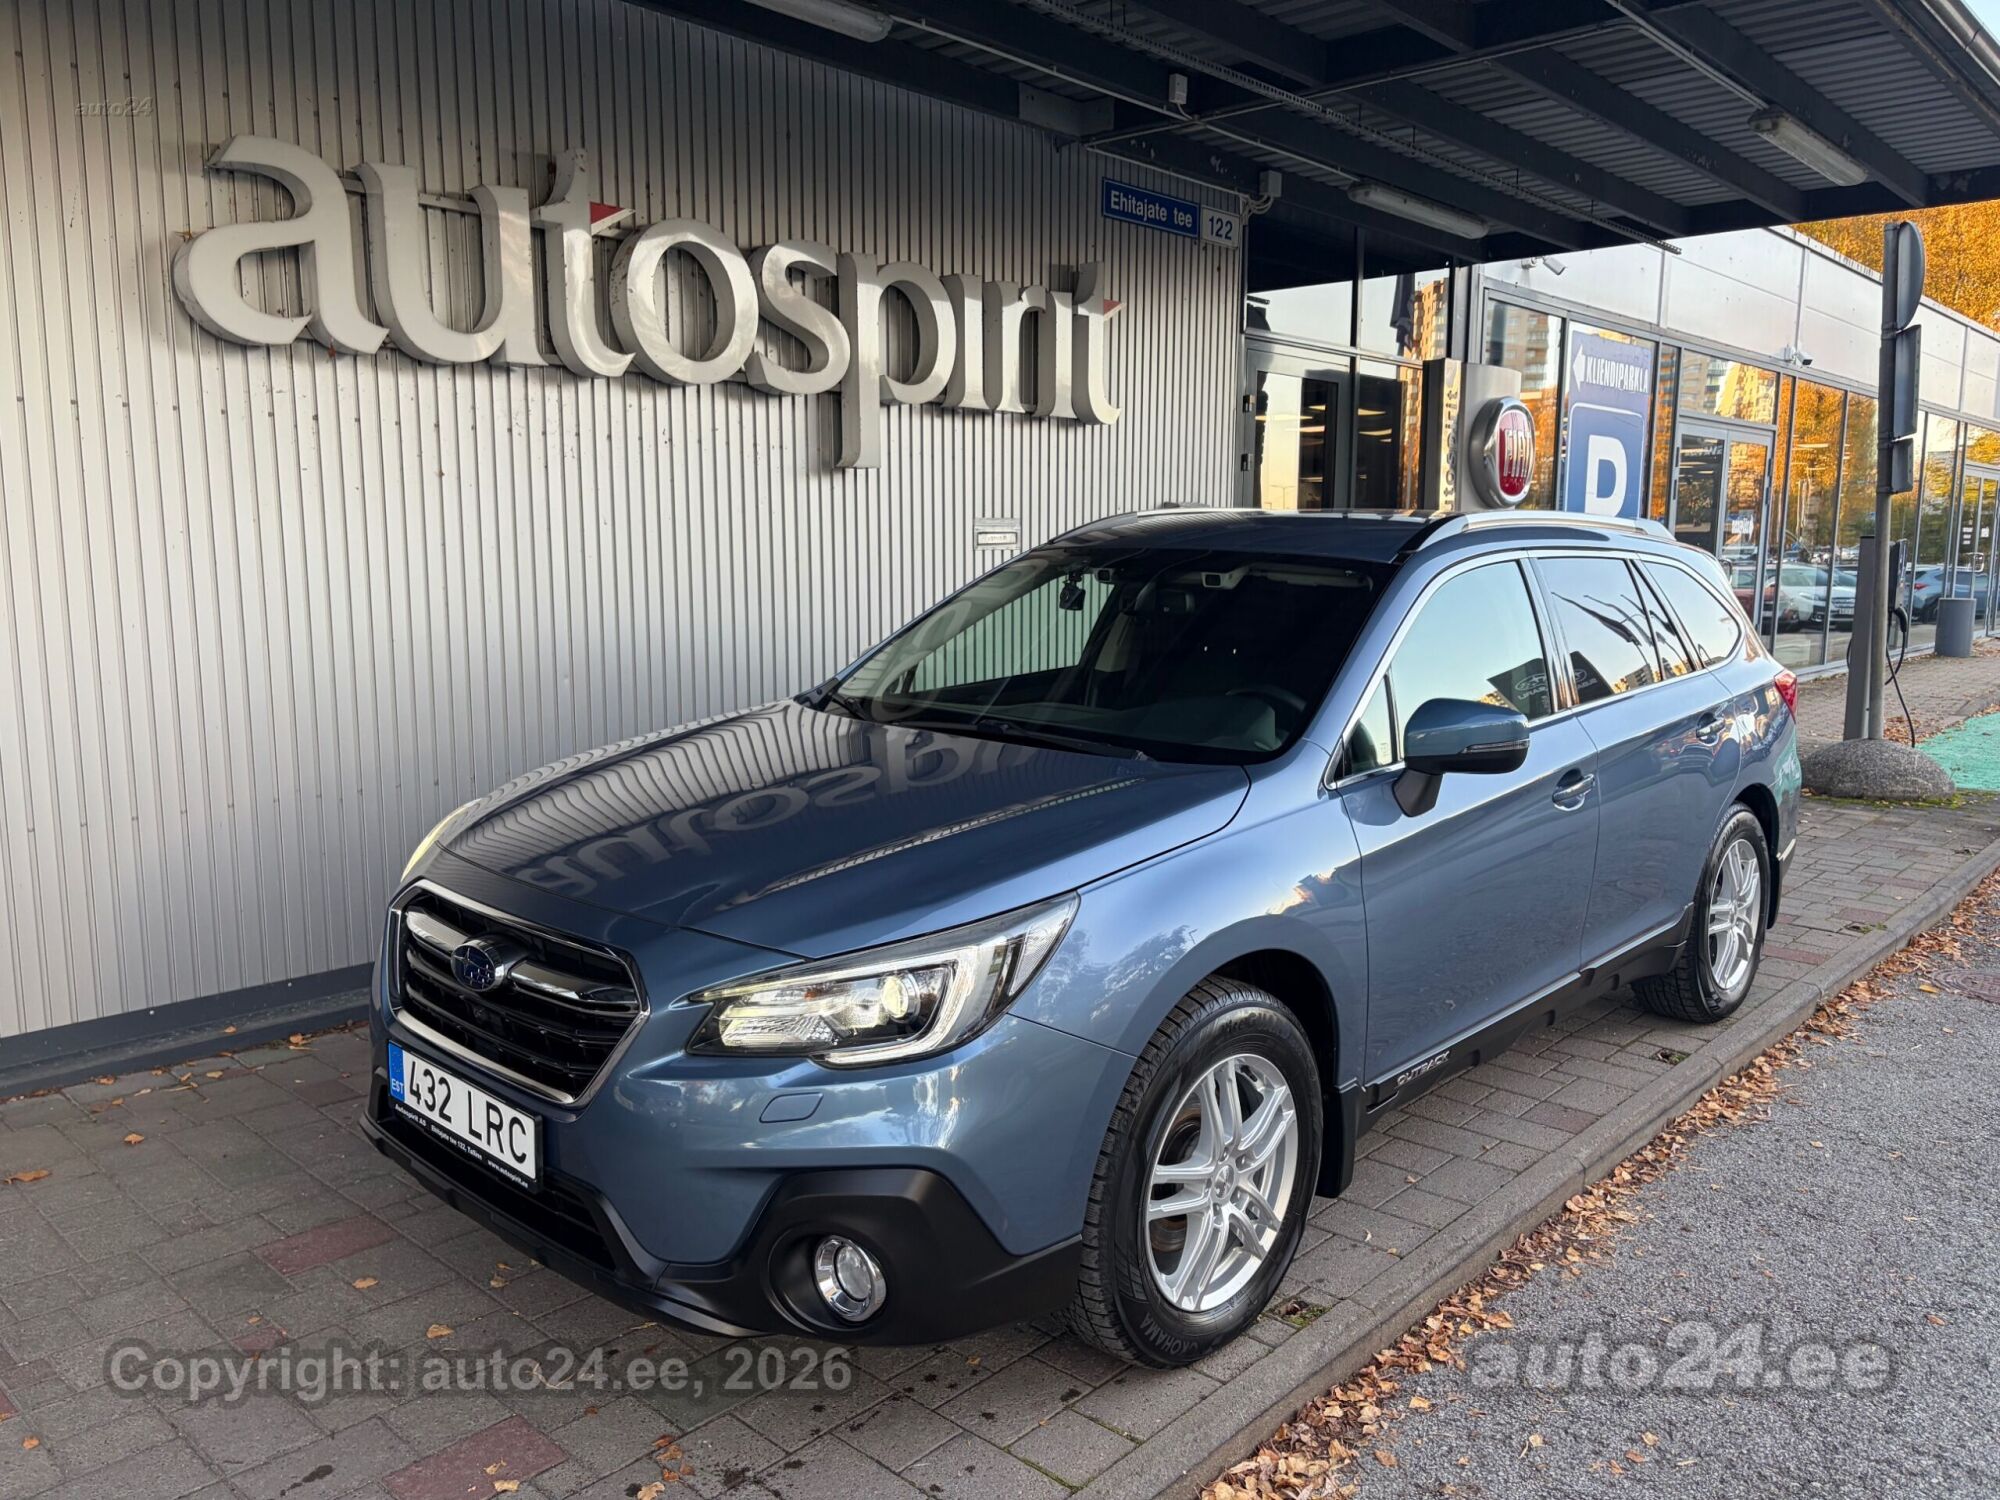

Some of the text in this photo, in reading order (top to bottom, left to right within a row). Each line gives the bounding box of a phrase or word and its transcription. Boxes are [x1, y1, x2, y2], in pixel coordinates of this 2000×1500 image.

[1110, 189, 1193, 228] Ehitajate tee
[1209, 215, 1233, 240] 122
[172, 134, 1122, 468] autospirit
[1586, 355, 1649, 393] KLIENDIPARKLA
[1443, 390, 1458, 511] utospirit
[1503, 429, 1531, 478] FIAT
[391, 1078, 404, 1095] EST
[1396, 1050, 1450, 1086] OUTBACK
[409, 1060, 527, 1164] 432 LRC
